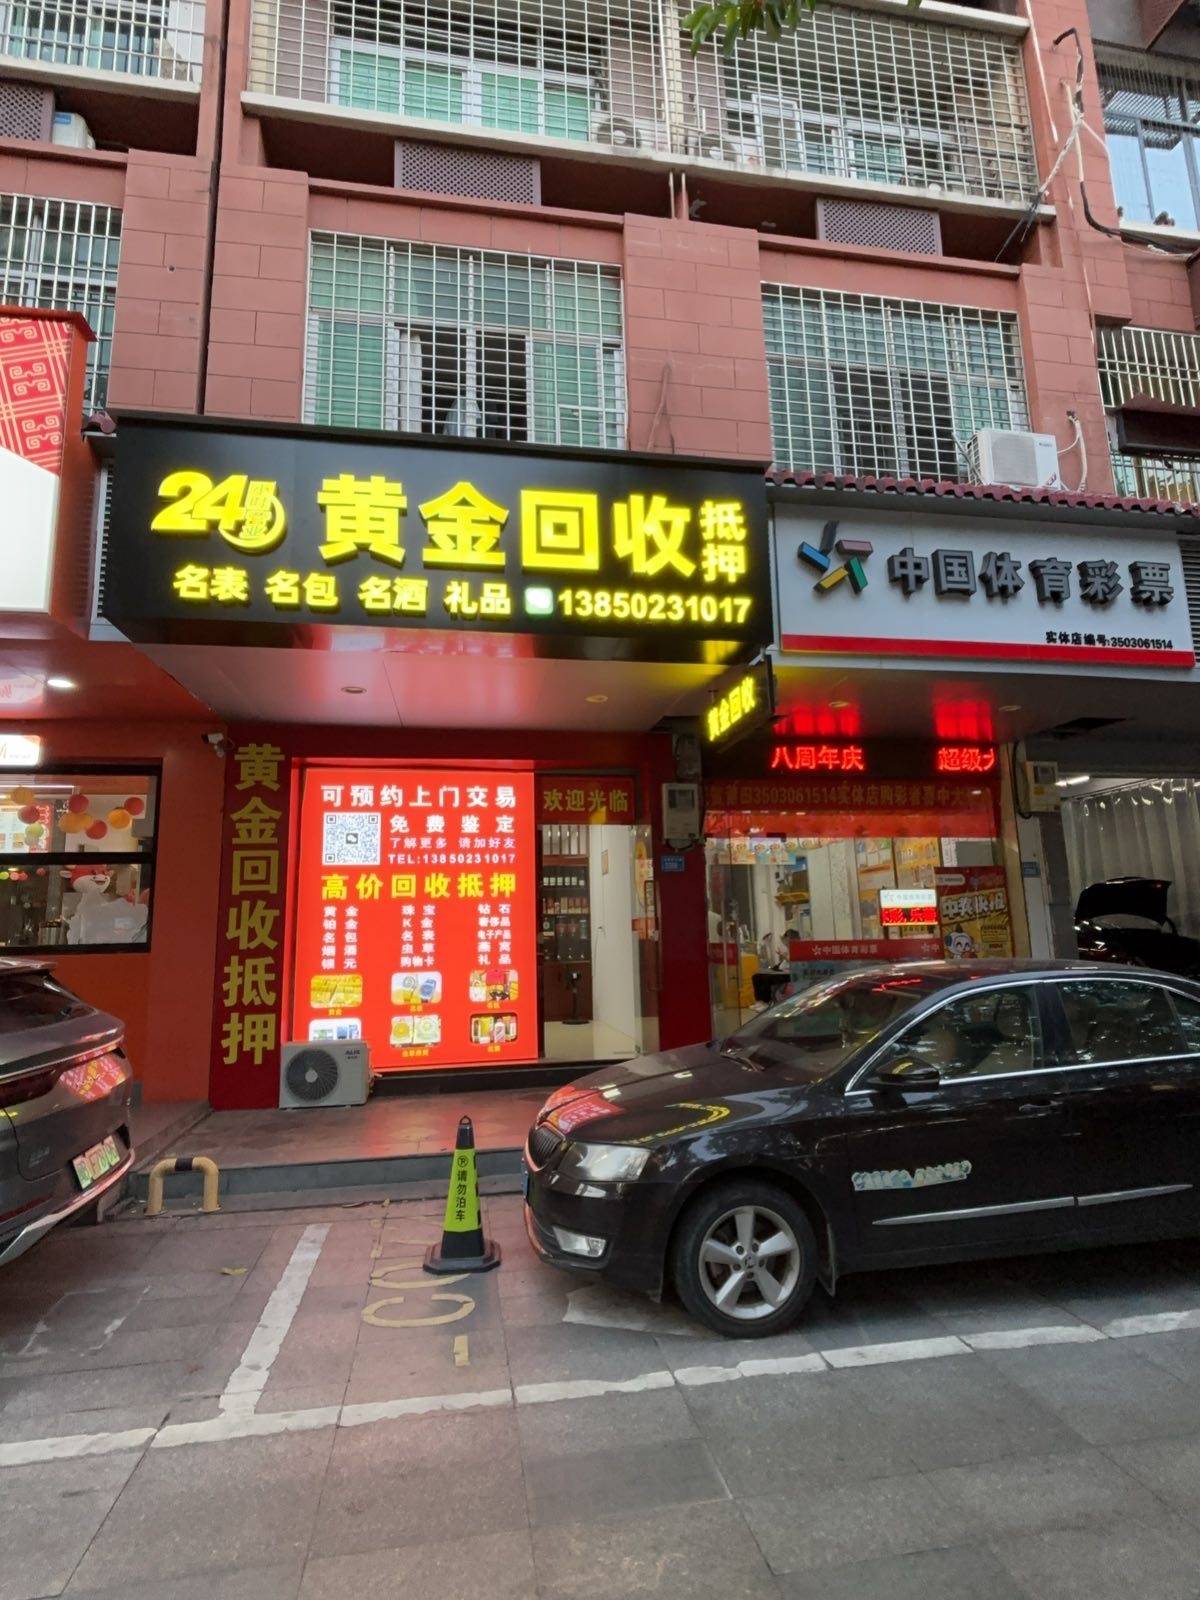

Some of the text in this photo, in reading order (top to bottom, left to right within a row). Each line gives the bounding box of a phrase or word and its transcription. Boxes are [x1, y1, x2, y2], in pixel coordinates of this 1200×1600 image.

[151, 470, 249, 534] 24
[316, 473, 696, 580] 黄金回收
[699, 499, 748, 585] 抵押
[173, 565, 752, 624] 名表 名包 名酒 礼品 13850231017
[887, 546, 1175, 606] 中国体育彩票
[770, 746, 866, 773] 八周年庆
[321, 784, 517, 808] 可预约上门交易
[543, 788, 629, 813] 欢迎光临
[390, 814, 516, 833] 免费鉴定
[390, 837, 517, 849] 了解更多 请加好友
[221, 743, 286, 1066] 黄金回收抵押
[321, 872, 517, 900] 高价回收抵押
[454, 1169, 468, 1223] 请勿泊车
